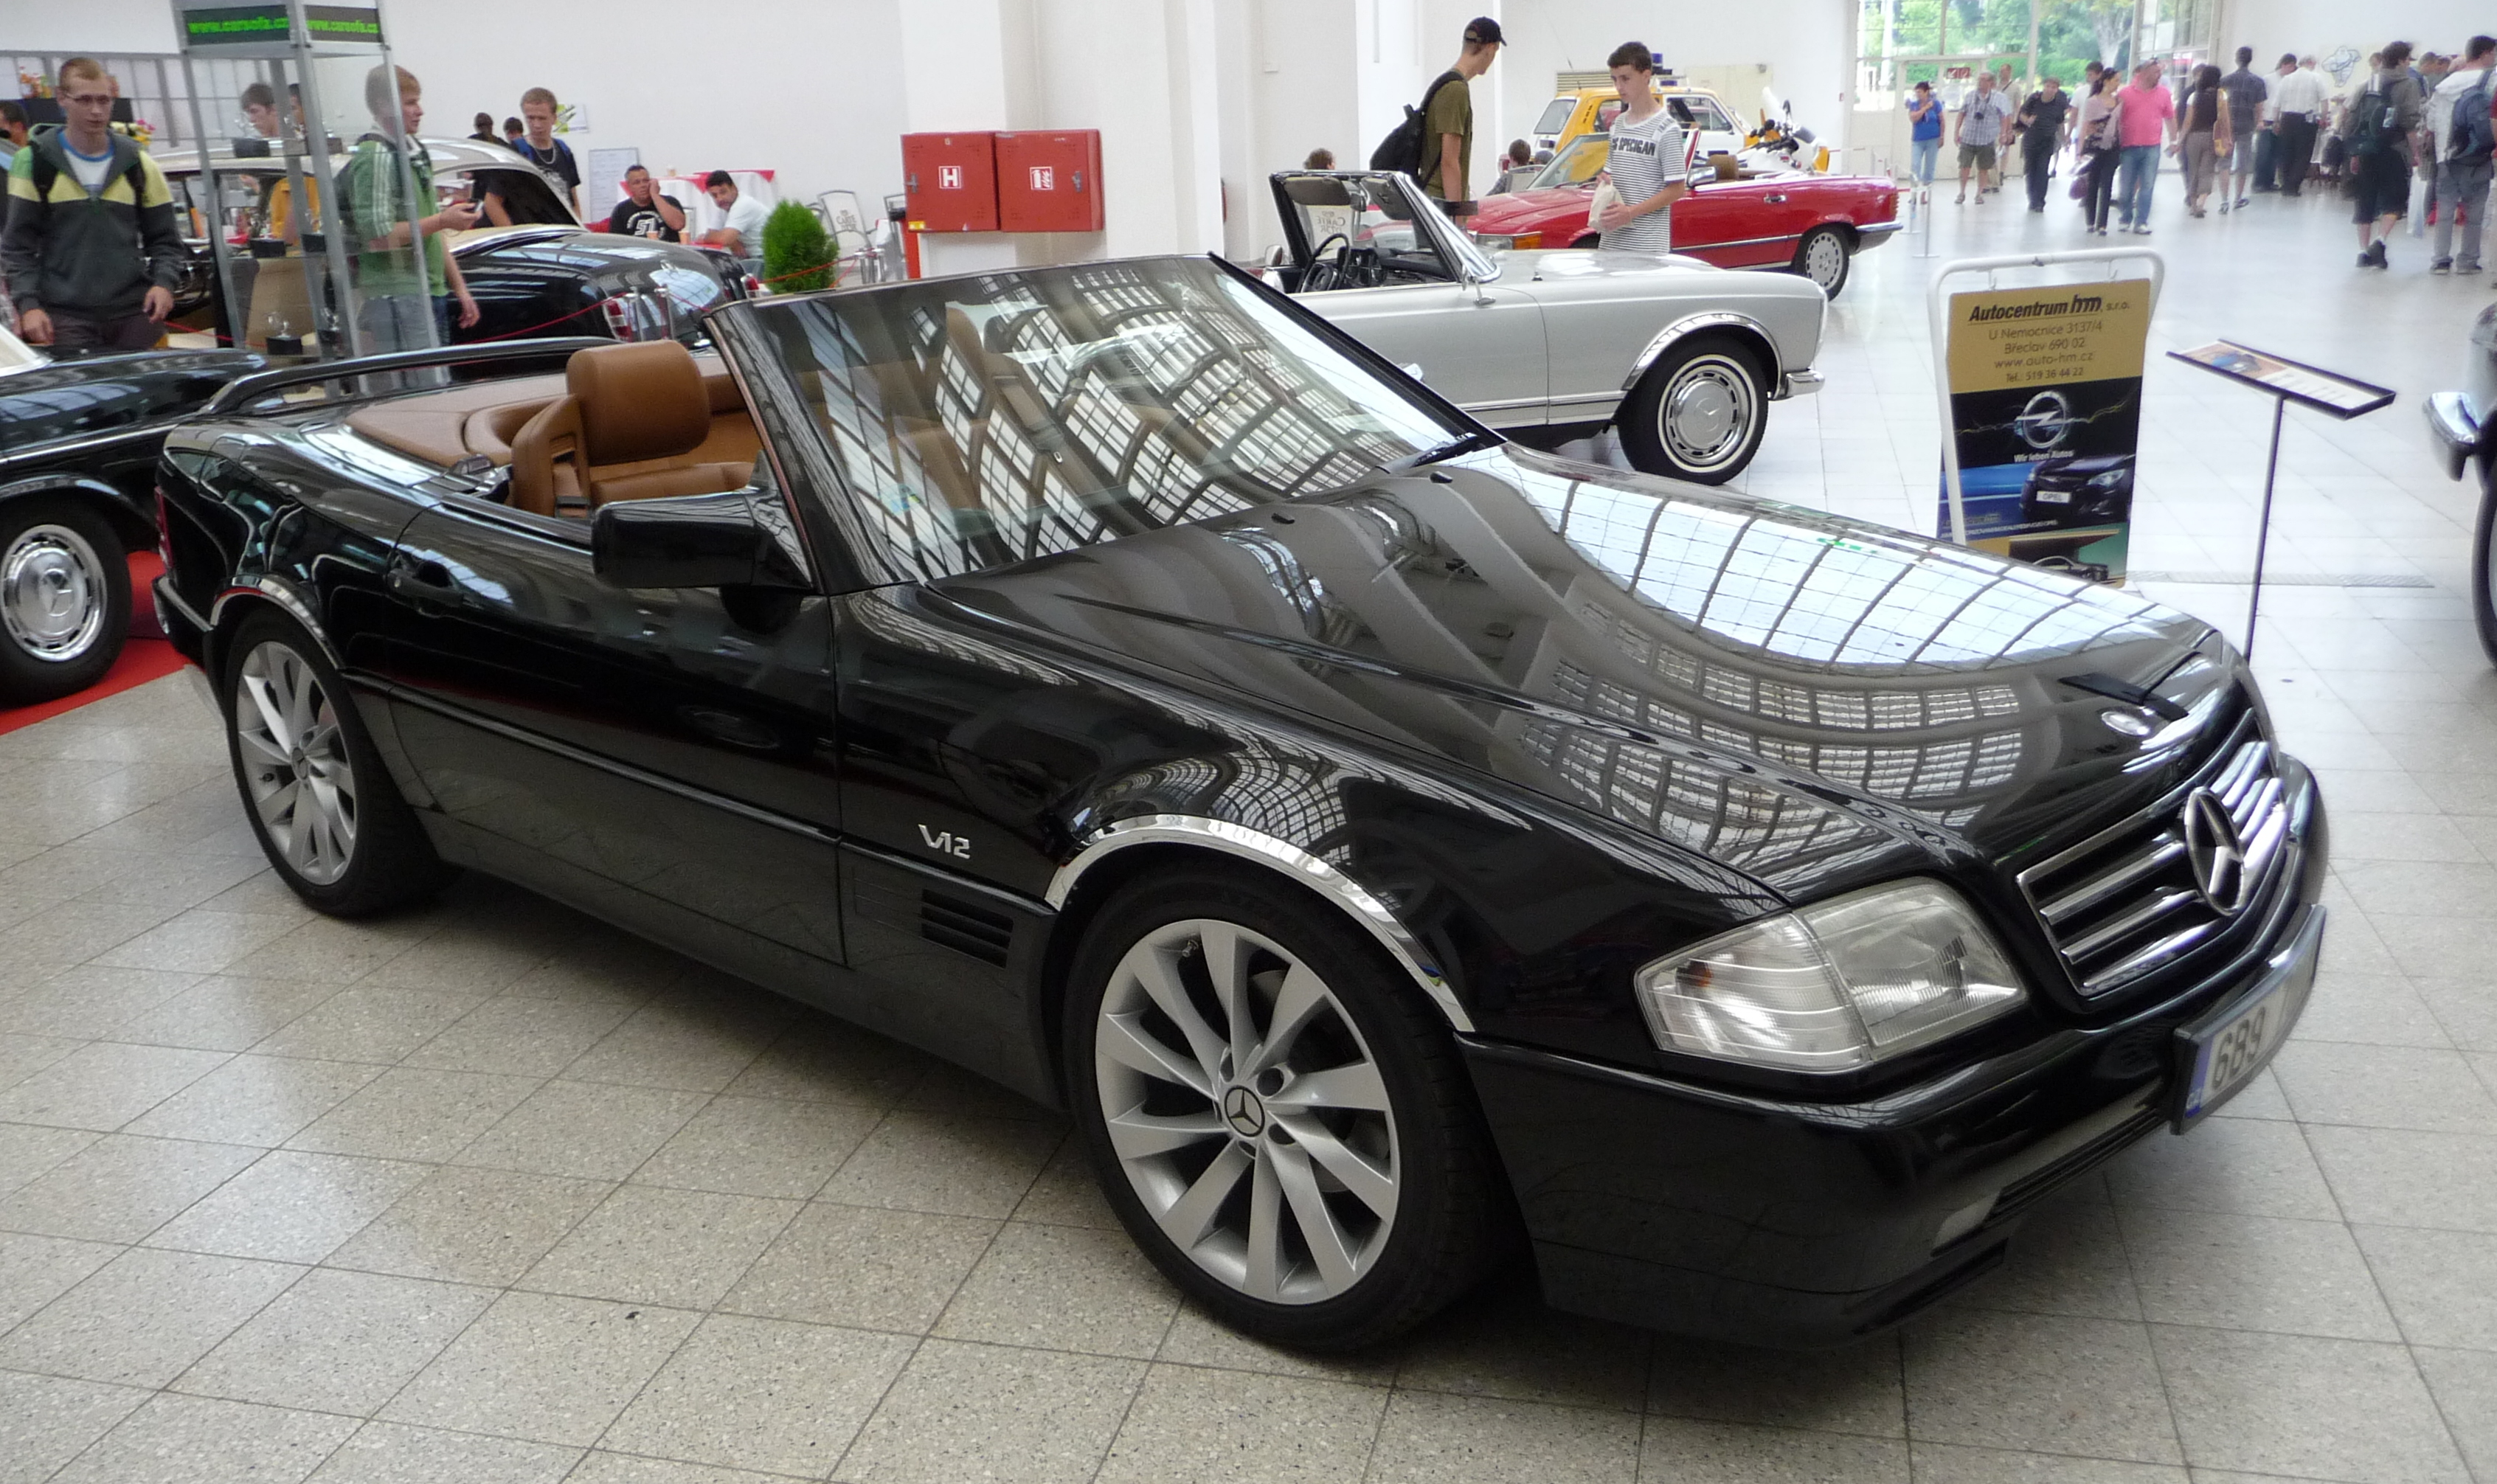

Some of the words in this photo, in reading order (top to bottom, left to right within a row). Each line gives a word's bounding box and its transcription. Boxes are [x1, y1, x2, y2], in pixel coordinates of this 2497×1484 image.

[942, 167, 958, 187] H
[1969, 302, 2068, 322] Autocentrum
[2106, 302, 2130, 311] s.r.o.
[2001, 326, 2064, 339] Nemocnice
[2066, 320, 2102, 334] 3137/4
[2005, 341, 2045, 354] Břeclav
[2048, 339, 2068, 350] 690
[2071, 337, 2086, 348] 02
[1995, 352, 2093, 368] www.auto-hm.cz
[2026, 370, 2043, 381] 519
[2046, 370, 2057, 379] 36
[2059, 368, 2071, 378] 44
[917, 824, 971, 859] V12
[2212, 1006, 2266, 1089] 689
